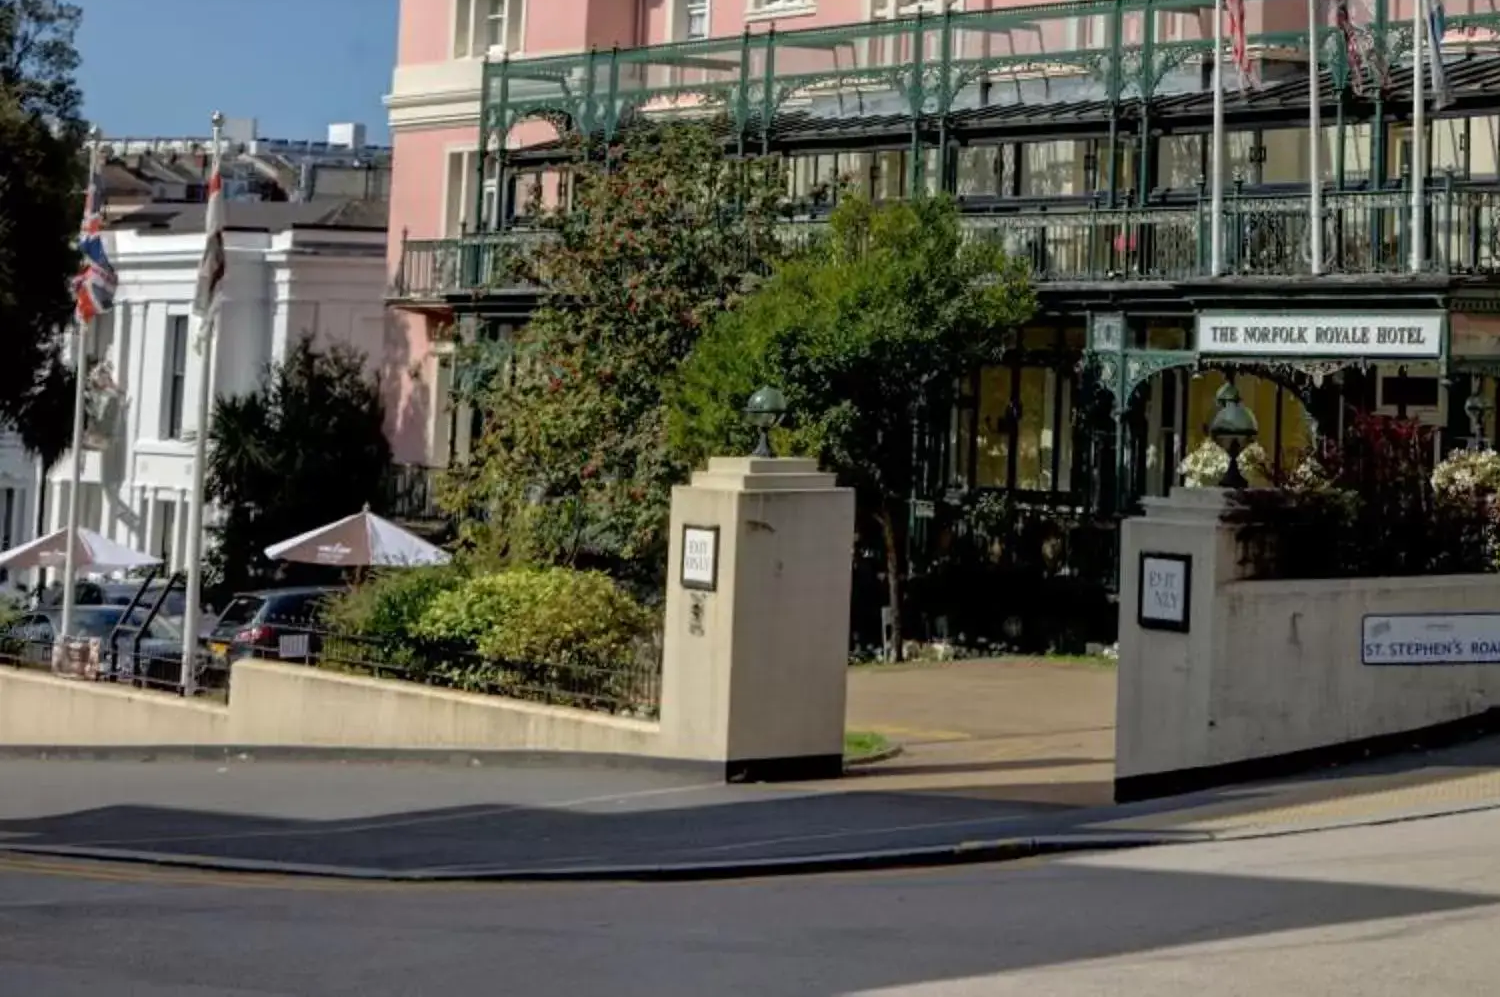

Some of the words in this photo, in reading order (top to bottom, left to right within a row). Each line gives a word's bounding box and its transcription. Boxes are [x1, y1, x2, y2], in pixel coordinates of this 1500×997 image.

[1210, 326, 1238, 343] THE
[1243, 326, 1308, 344] NORFOLK
[1315, 326, 1370, 344] ROYALE
[1376, 326, 1425, 344] HOTEL
[1390, 639, 1462, 656] STEPHEN'S
